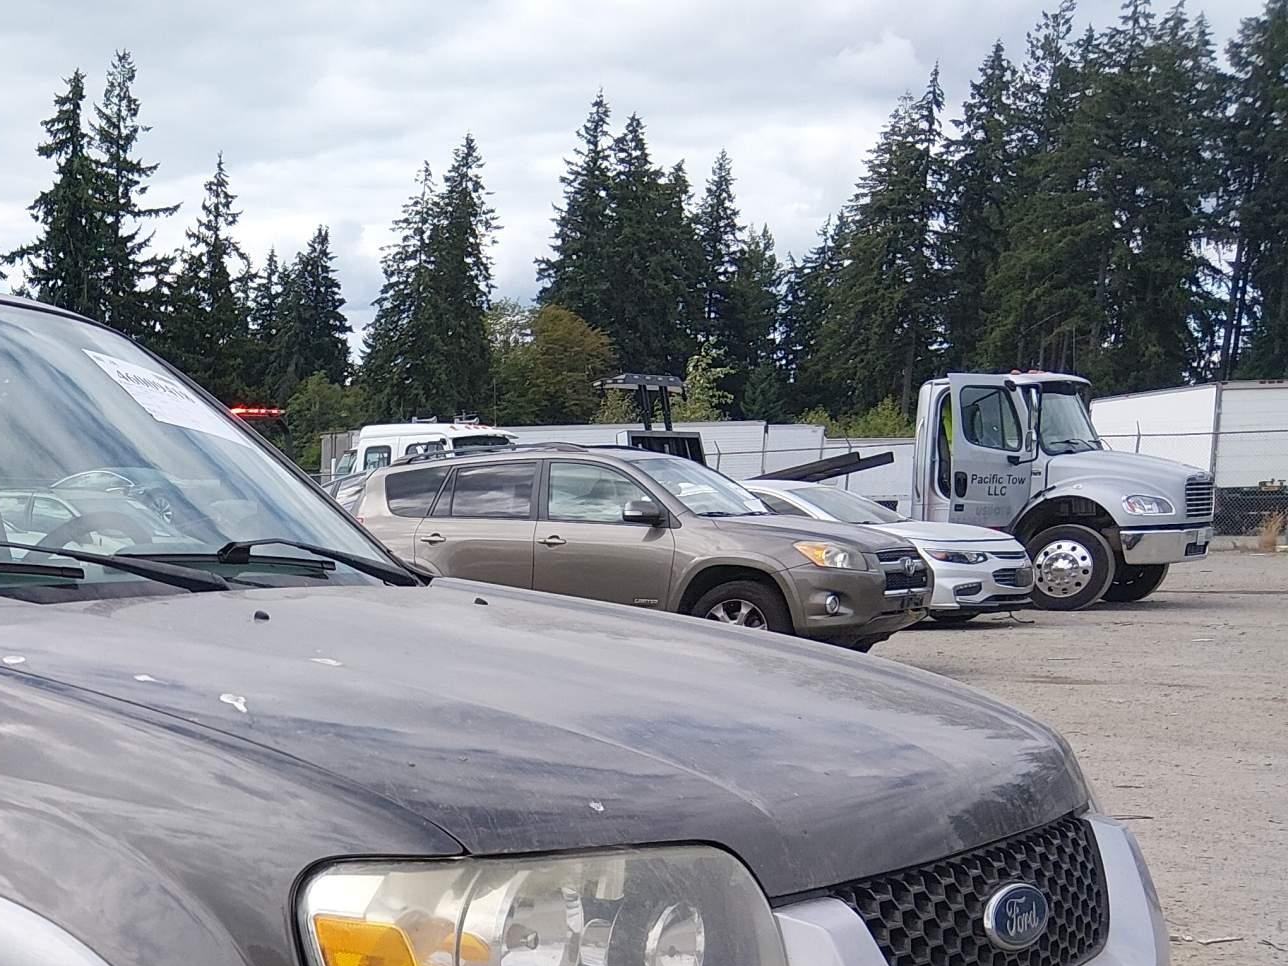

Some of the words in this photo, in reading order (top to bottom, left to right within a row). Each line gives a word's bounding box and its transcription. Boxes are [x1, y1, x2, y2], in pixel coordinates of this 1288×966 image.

[971, 473, 1004, 485] Pacific
[1006, 474, 1027, 485] Tow
[987, 485, 1008, 496] LLC
[1005, 896, 1040, 937] Ford
